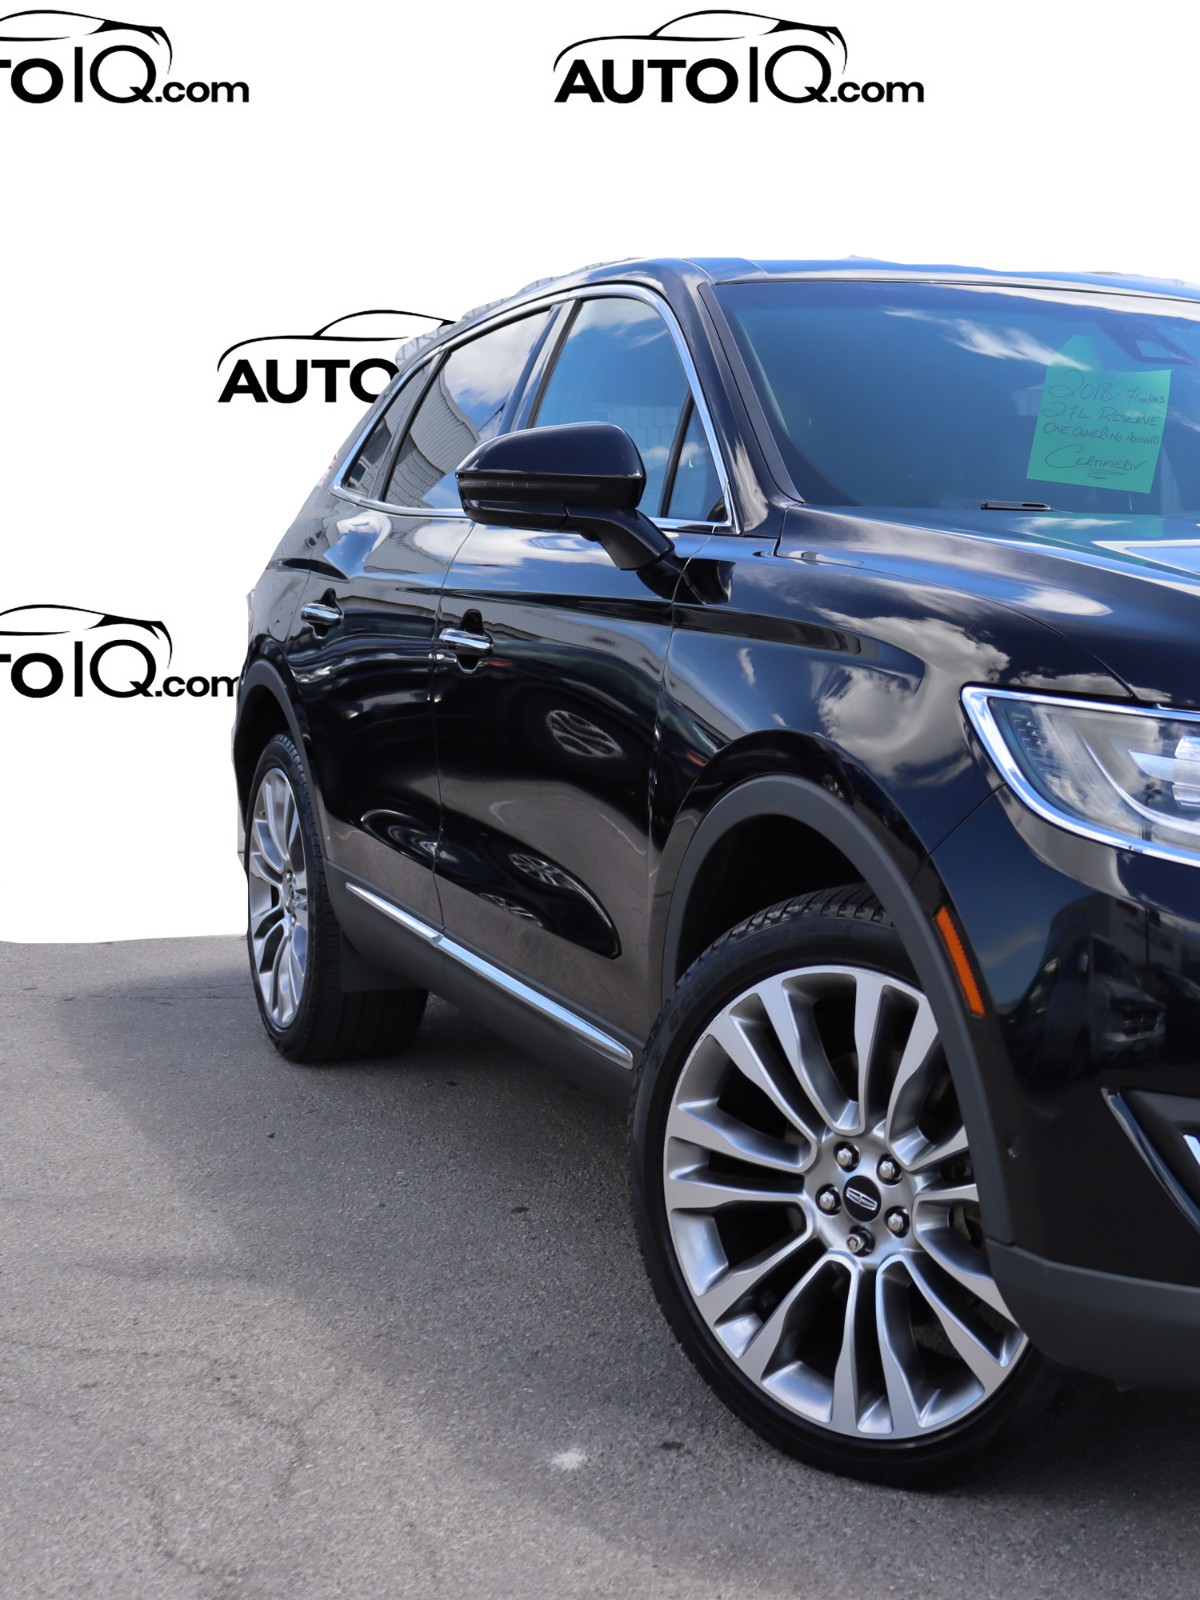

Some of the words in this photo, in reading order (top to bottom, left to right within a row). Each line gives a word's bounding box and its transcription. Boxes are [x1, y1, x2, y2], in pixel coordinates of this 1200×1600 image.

[1099, 406, 1161, 426] RESERVE
[1043, 421, 1071, 436] ONE
[1045, 444, 1133, 471] CERTIFIED
